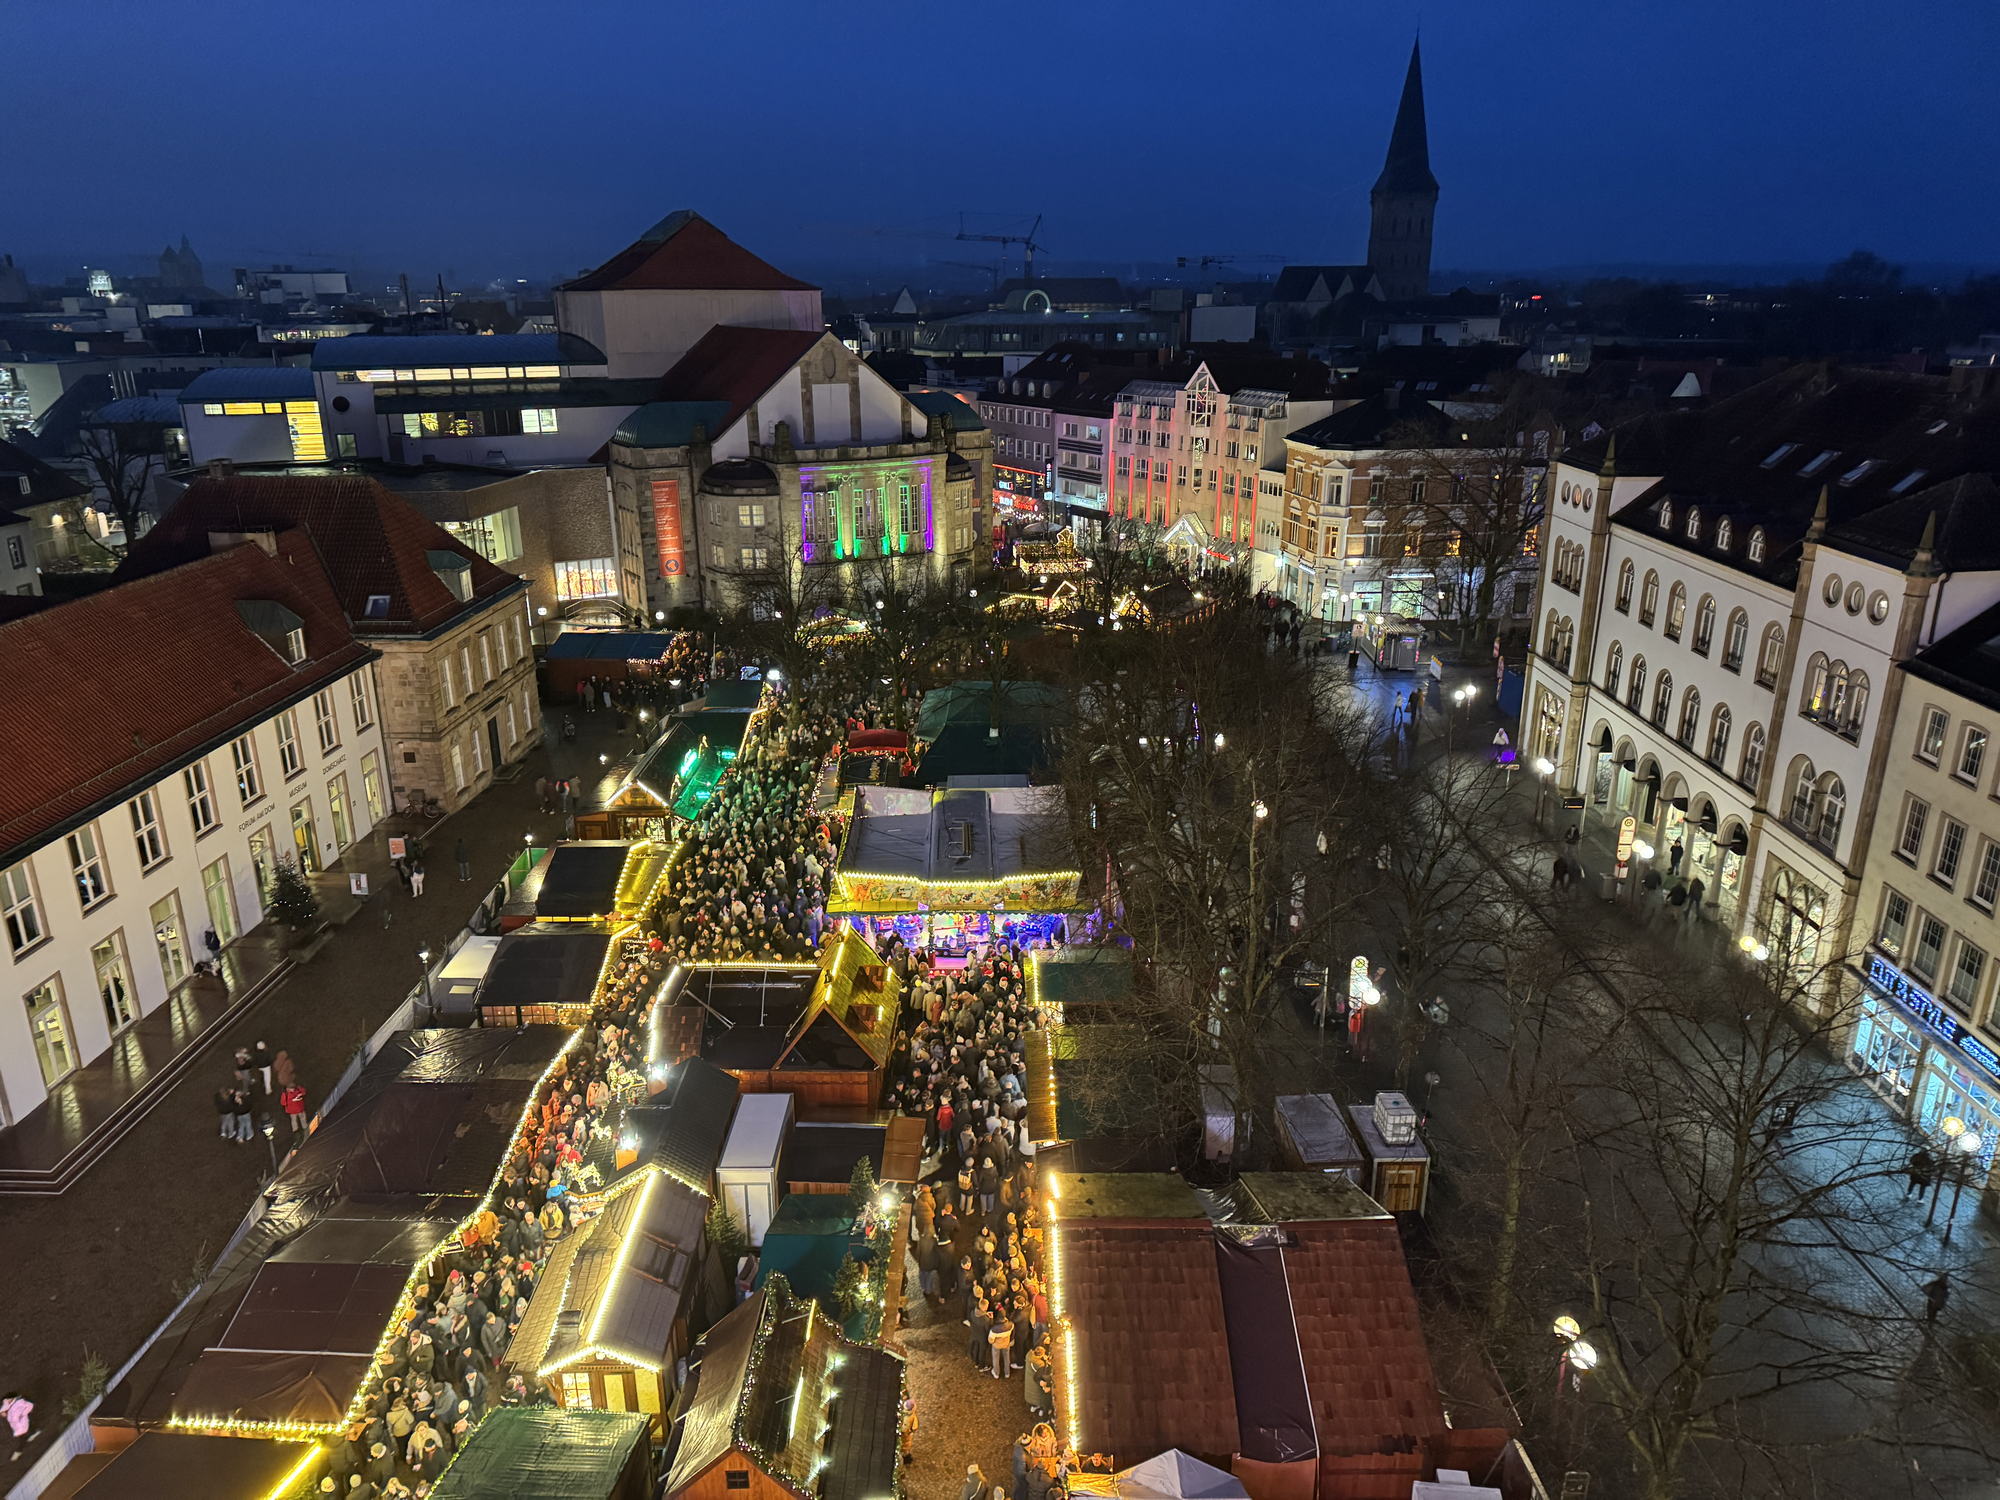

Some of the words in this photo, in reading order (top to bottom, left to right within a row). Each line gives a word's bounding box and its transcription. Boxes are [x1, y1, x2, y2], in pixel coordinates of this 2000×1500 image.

[322, 754, 347, 775] DOMSCHATZ
[288, 781, 308, 798] MUSEUM
[238, 816, 256, 832] FORUM
